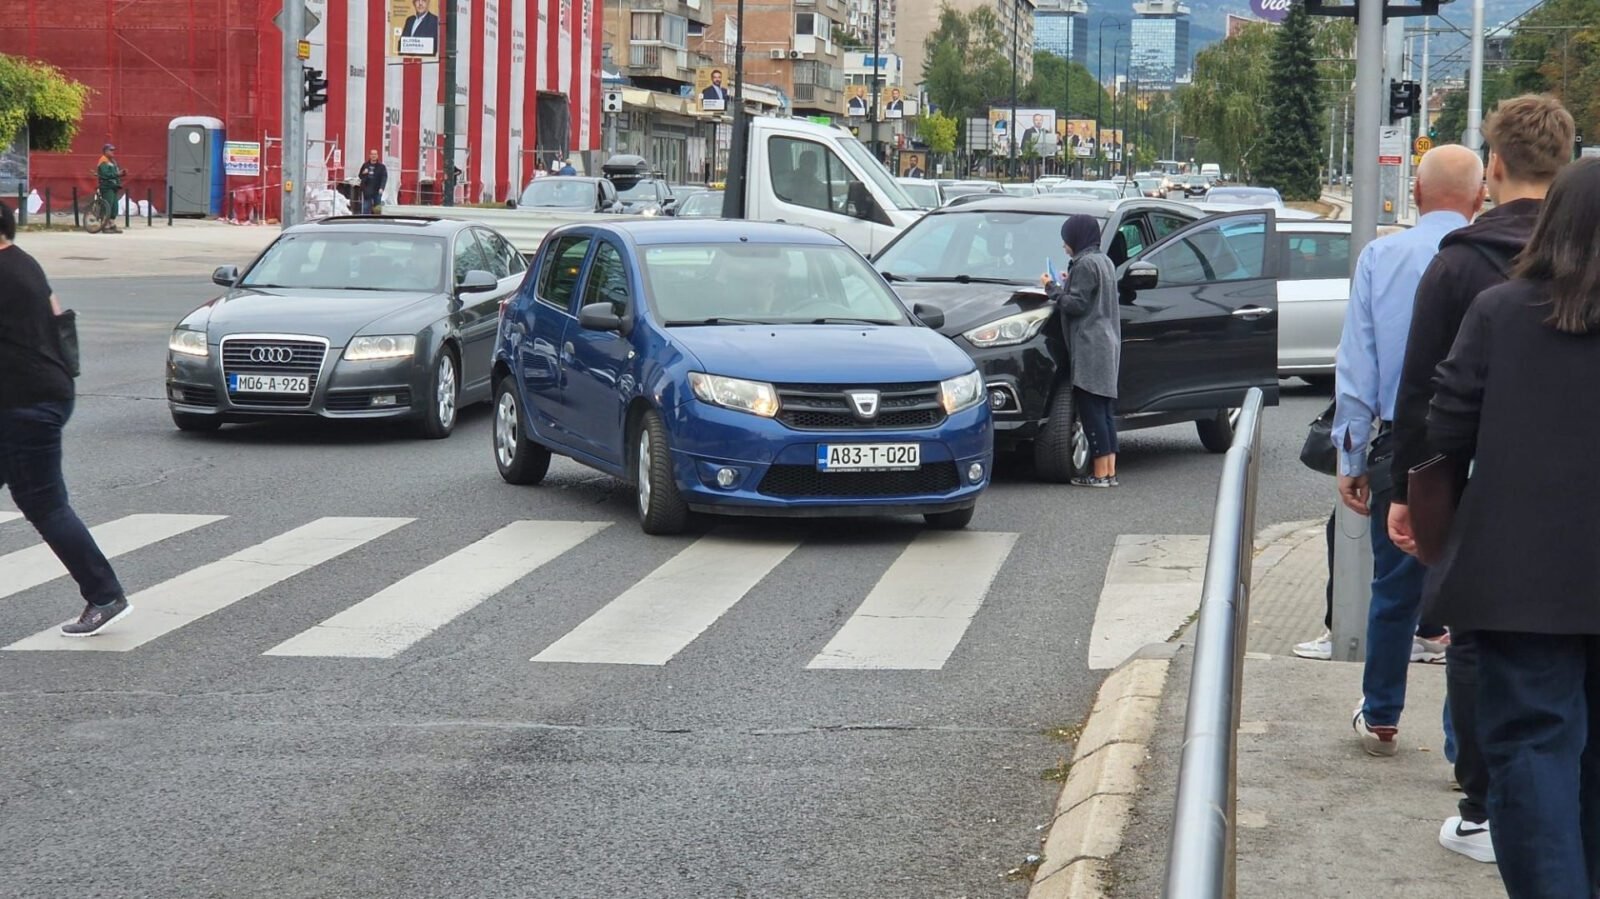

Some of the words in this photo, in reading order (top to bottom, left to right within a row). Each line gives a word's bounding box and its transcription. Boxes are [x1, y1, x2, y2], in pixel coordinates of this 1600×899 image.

[1418, 140, 1429, 151] 50
[239, 377, 306, 391] M06-A-926
[830, 446, 917, 465] A83-T-020
